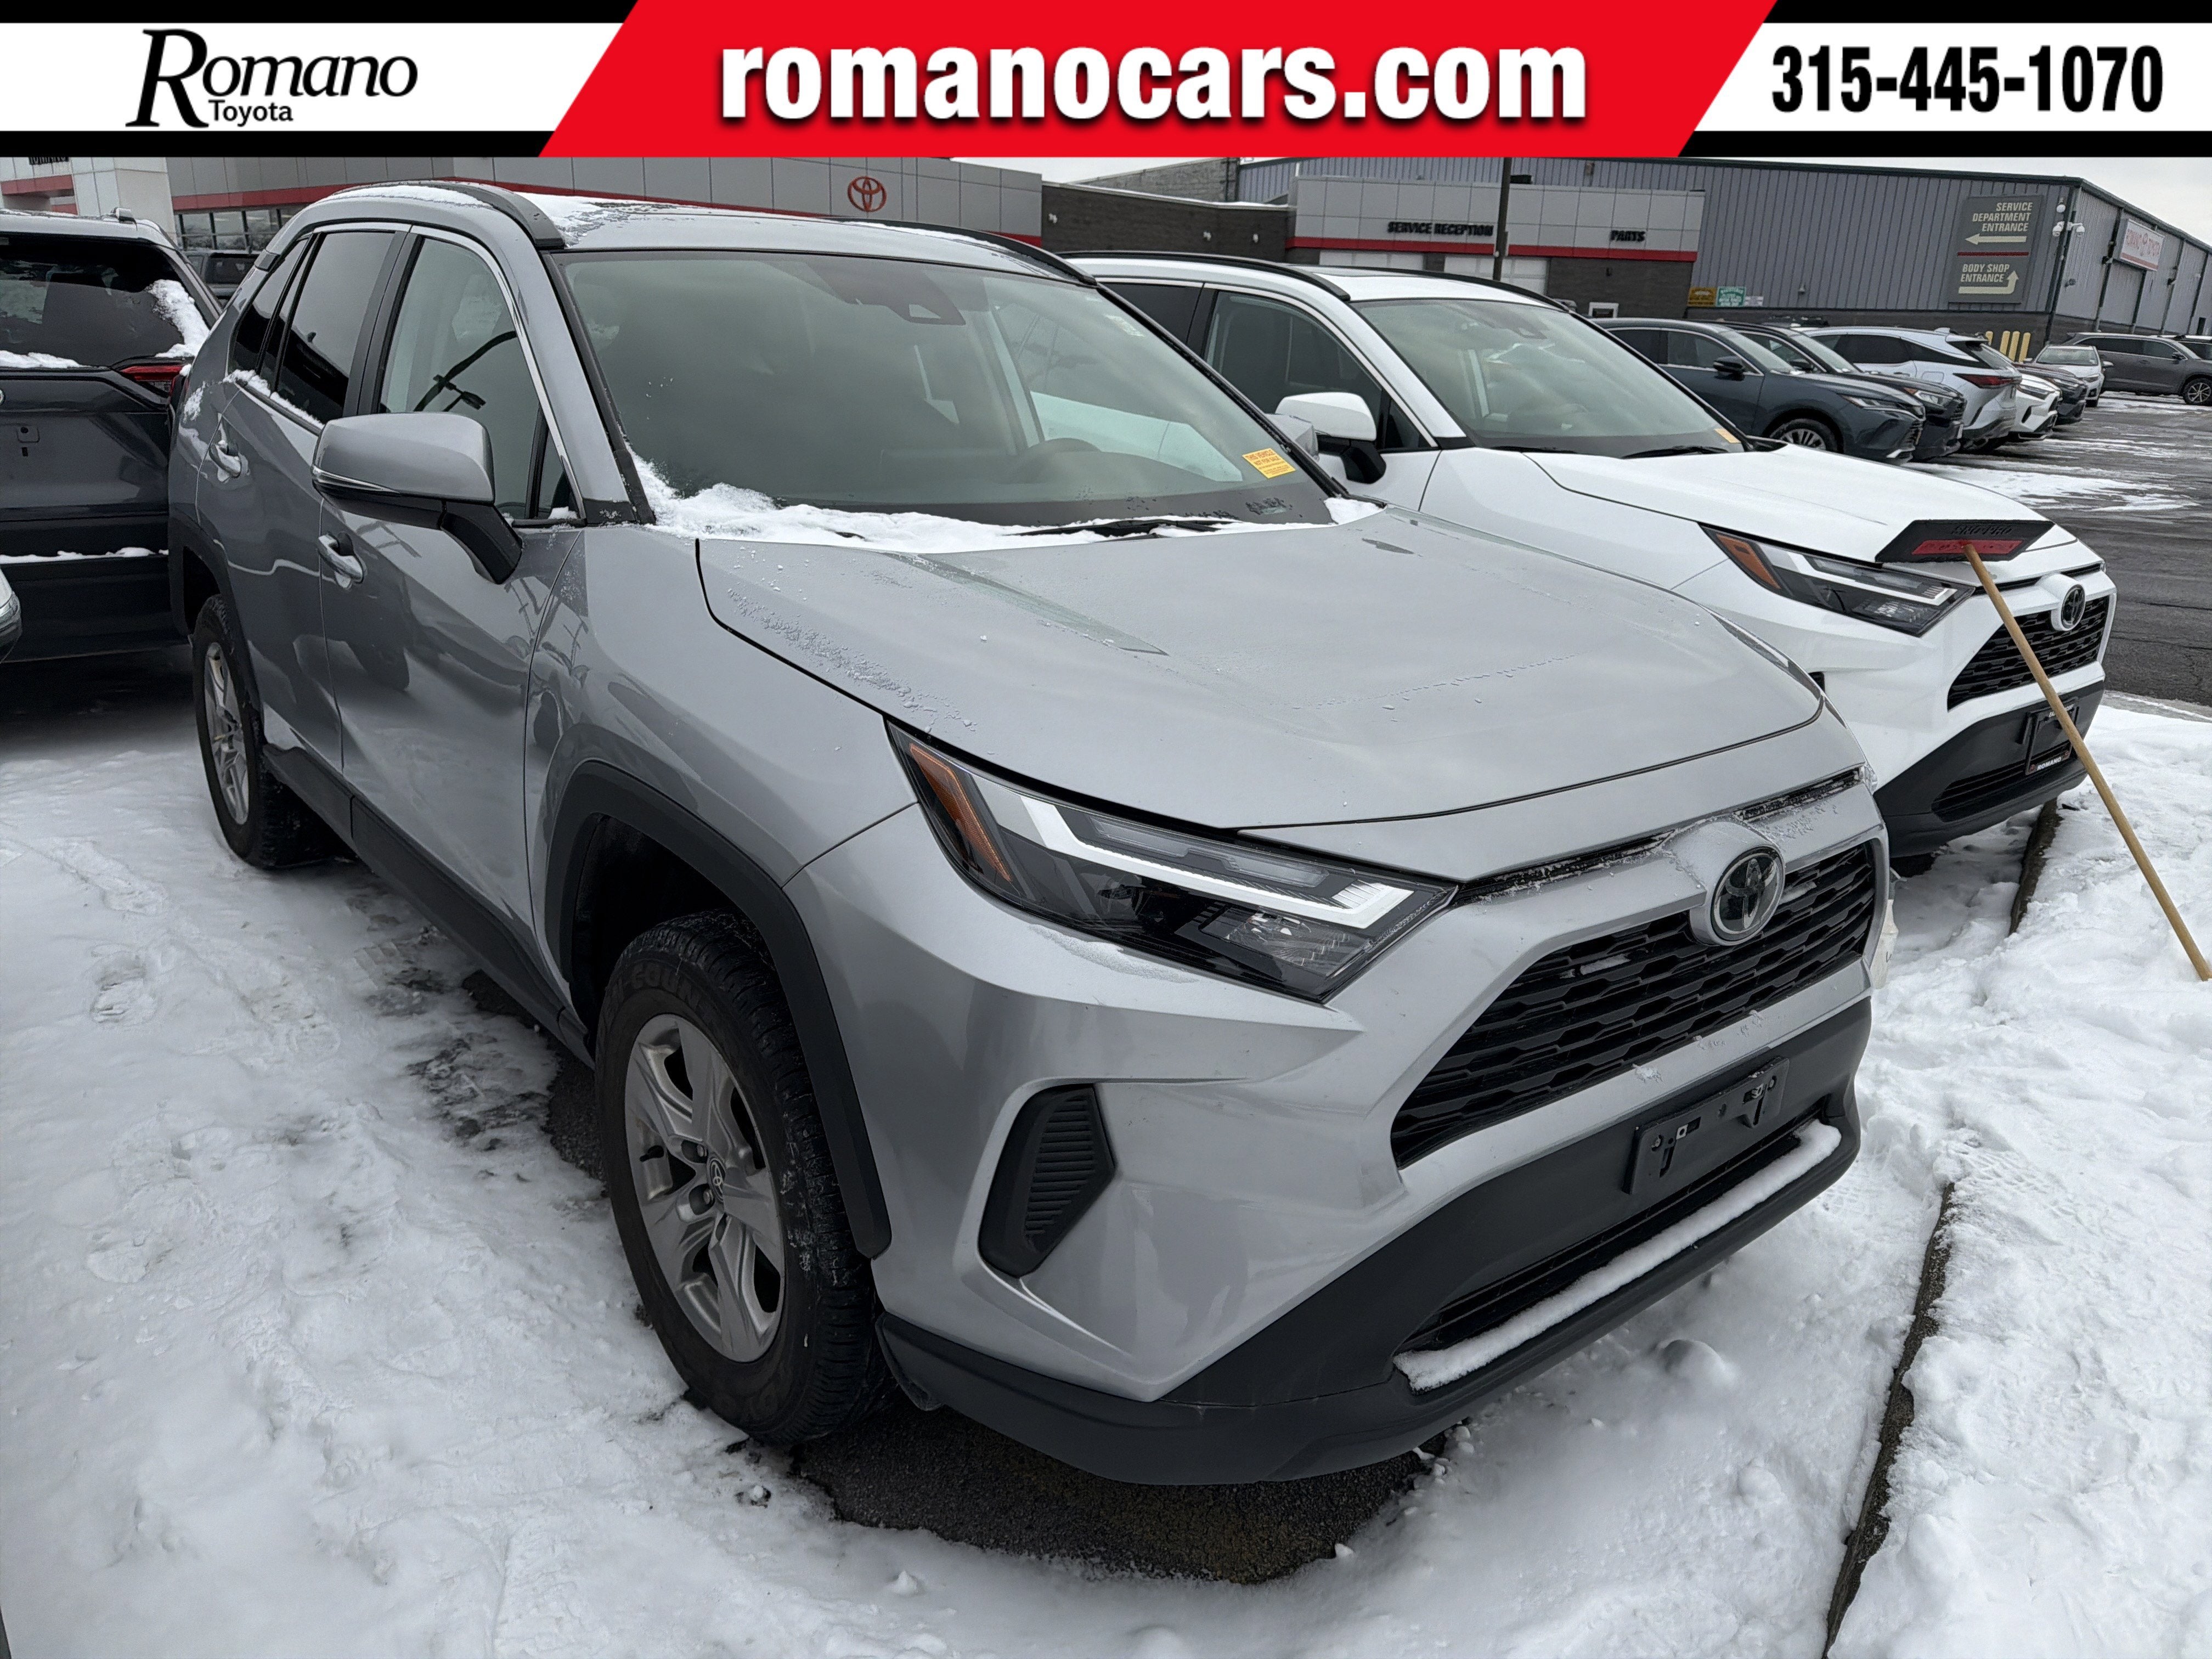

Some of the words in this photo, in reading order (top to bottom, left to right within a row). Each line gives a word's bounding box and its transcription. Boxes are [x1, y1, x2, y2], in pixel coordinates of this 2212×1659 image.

[1996, 202, 2033, 211] SERVICE
[1972, 212, 2031, 222] DEPARTMENT
[1387, 221, 1432, 234] SERVICE
[1434, 223, 1494, 236] RECEPTION
[1982, 223, 2029, 232] ENTRANCE
[1610, 230, 1645, 242] PARTS
[1962, 263, 1985, 273] BODY
[1987, 263, 2010, 273] SHOP
[1960, 273, 2004, 283] ENTRANCE
[2037, 757, 2062, 771] ROMANO
